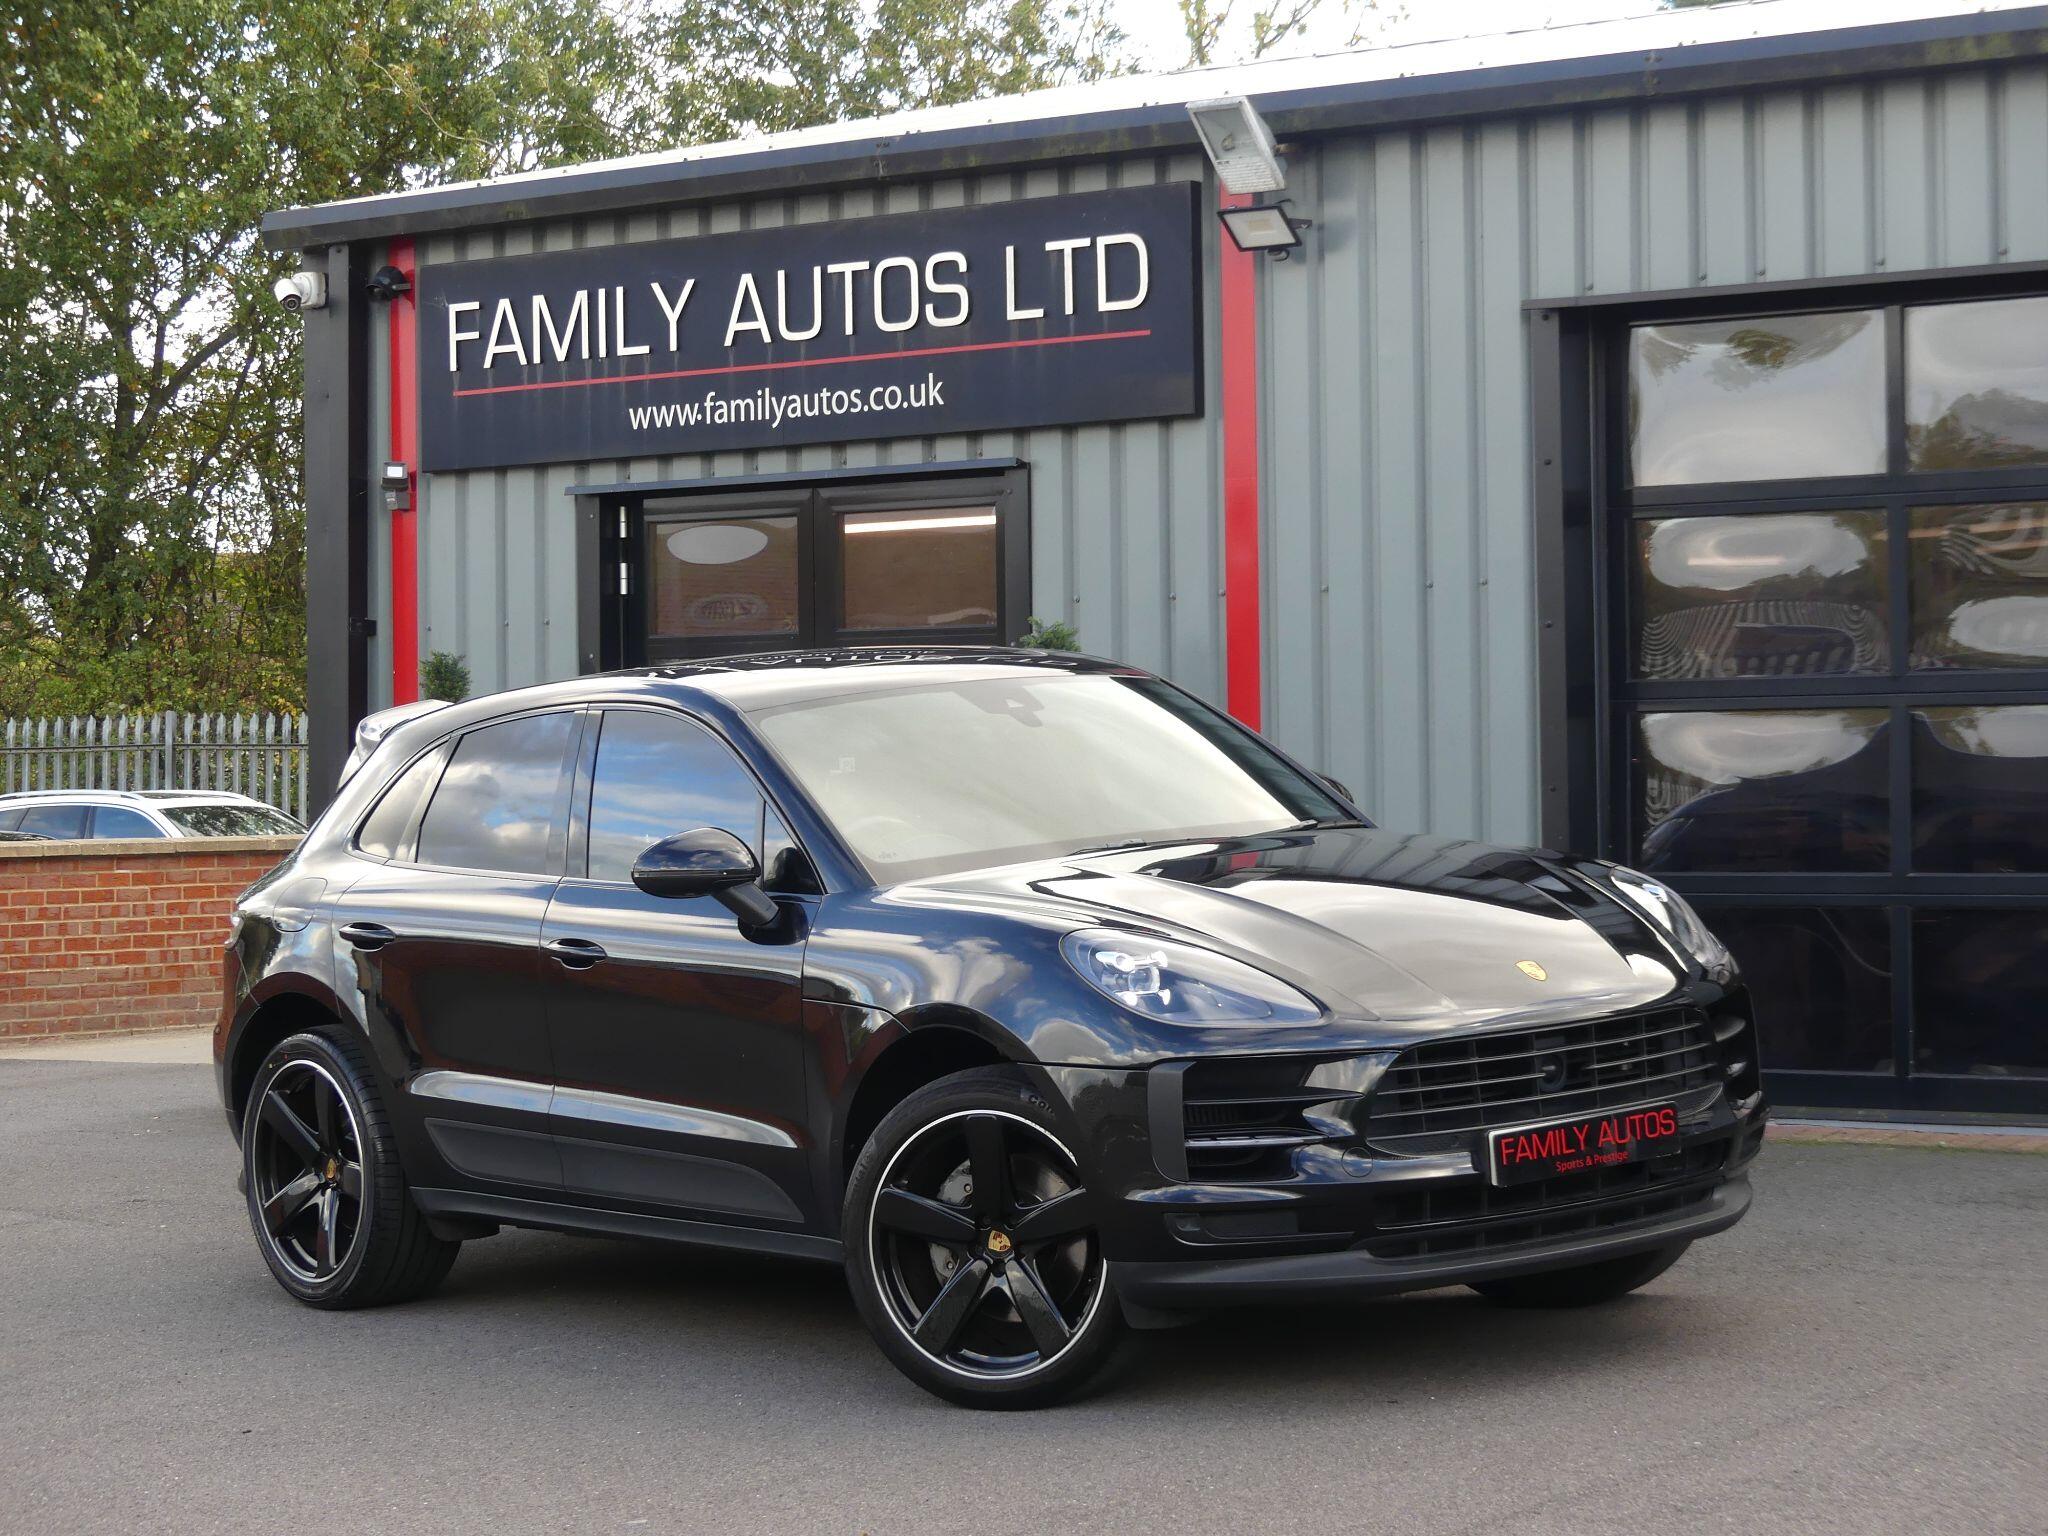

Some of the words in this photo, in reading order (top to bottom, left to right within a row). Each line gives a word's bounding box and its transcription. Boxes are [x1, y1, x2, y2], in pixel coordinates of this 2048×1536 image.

[447, 279, 697, 371] FAMILY
[724, 251, 970, 347] AUTOS
[1004, 232, 1150, 321] LTD
[628, 372, 945, 430] www.familyautos.co.uk
[1501, 1124, 1589, 1165] FAMILY
[1598, 1108, 1676, 1147] AUTOS
[1555, 1159, 1585, 1173] Sports
[1585, 1155, 1593, 1166] &
[1593, 1150, 1629, 1165] Prestige
